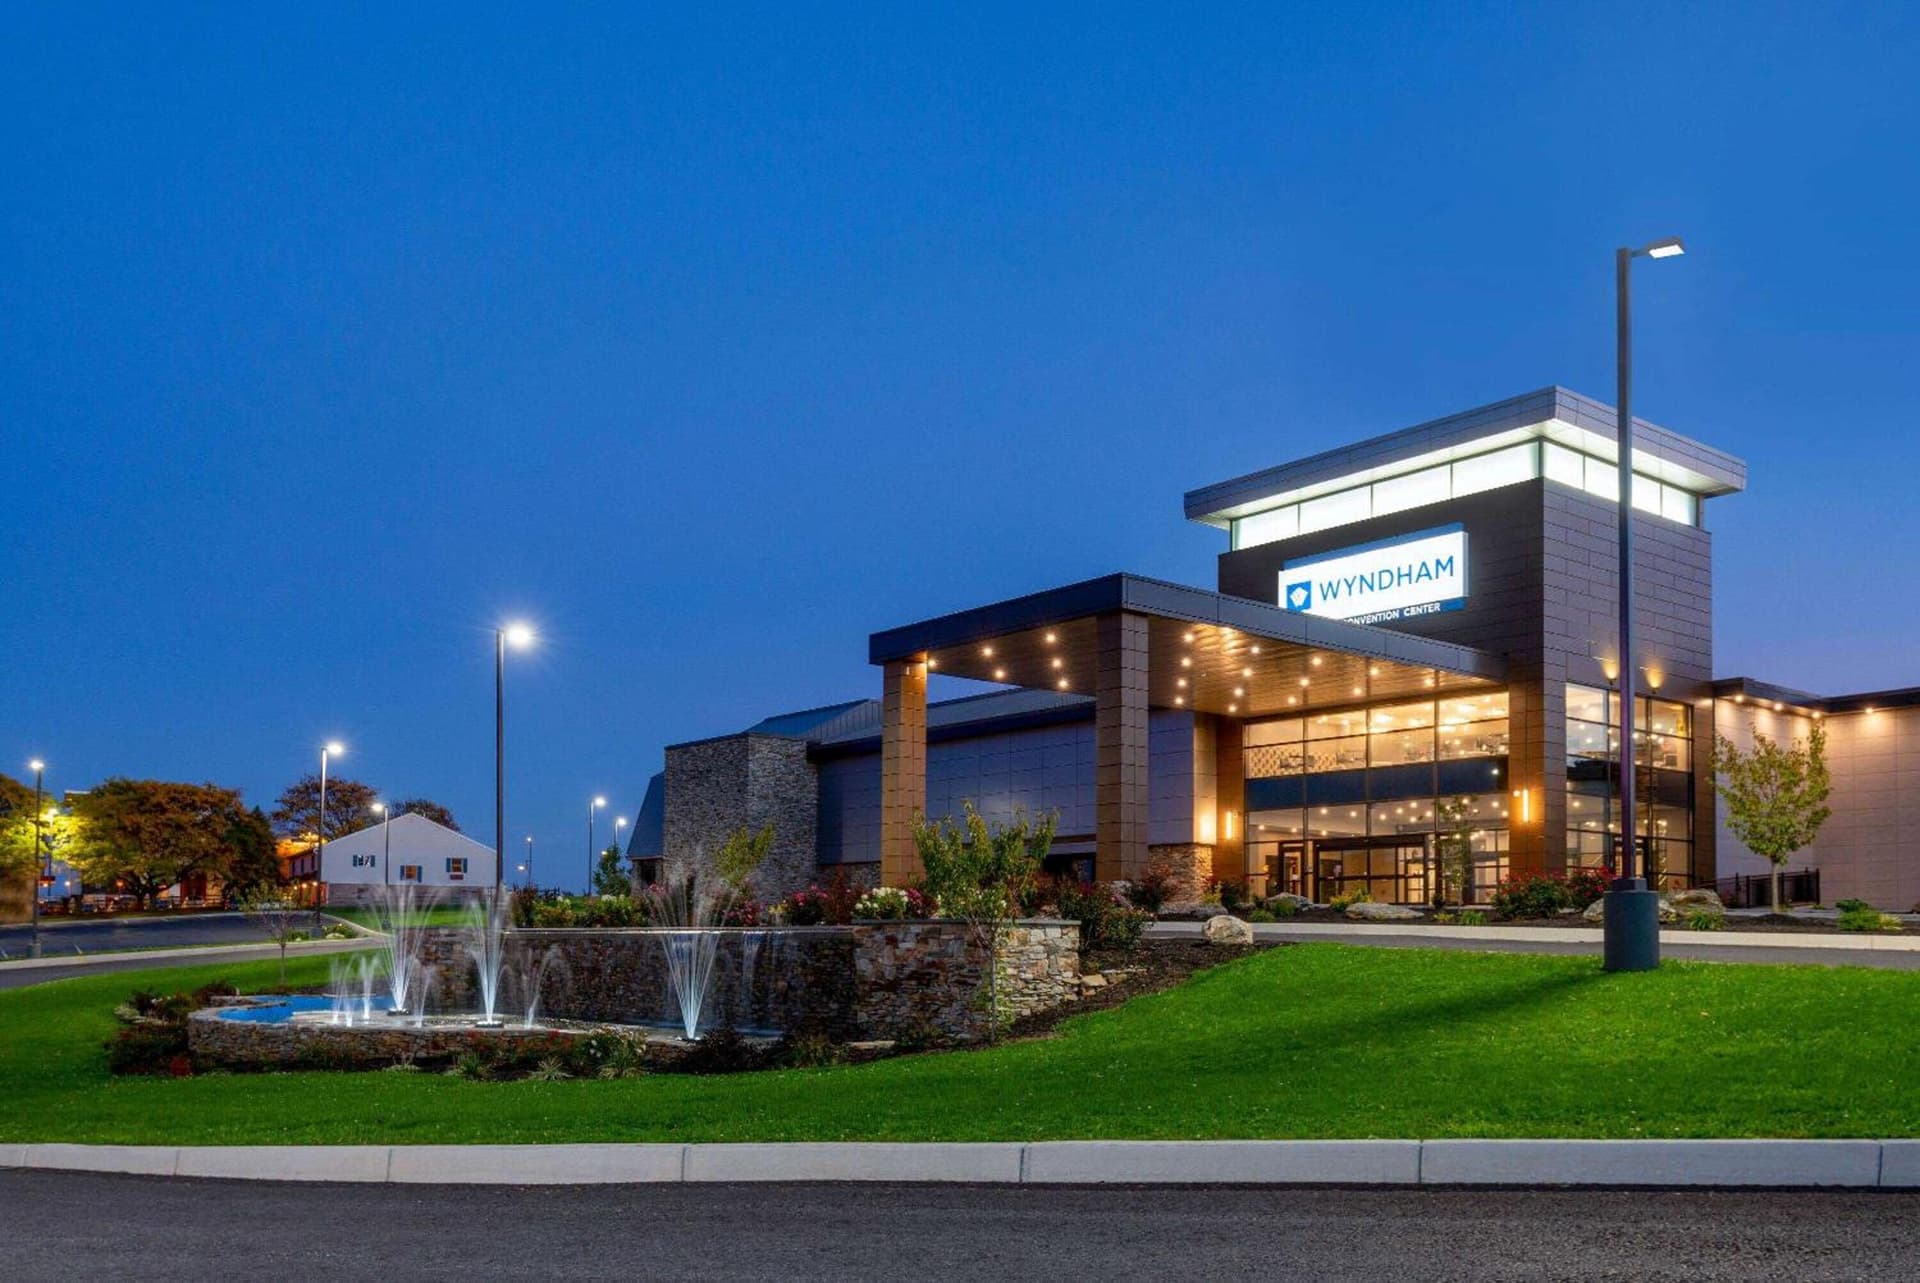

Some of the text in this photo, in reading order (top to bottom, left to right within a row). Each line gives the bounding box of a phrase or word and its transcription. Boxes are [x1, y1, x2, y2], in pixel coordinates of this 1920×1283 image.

[1320, 556, 1454, 601] WYNDHAM
[1343, 602, 1441, 625] ONVENTION CENTER
